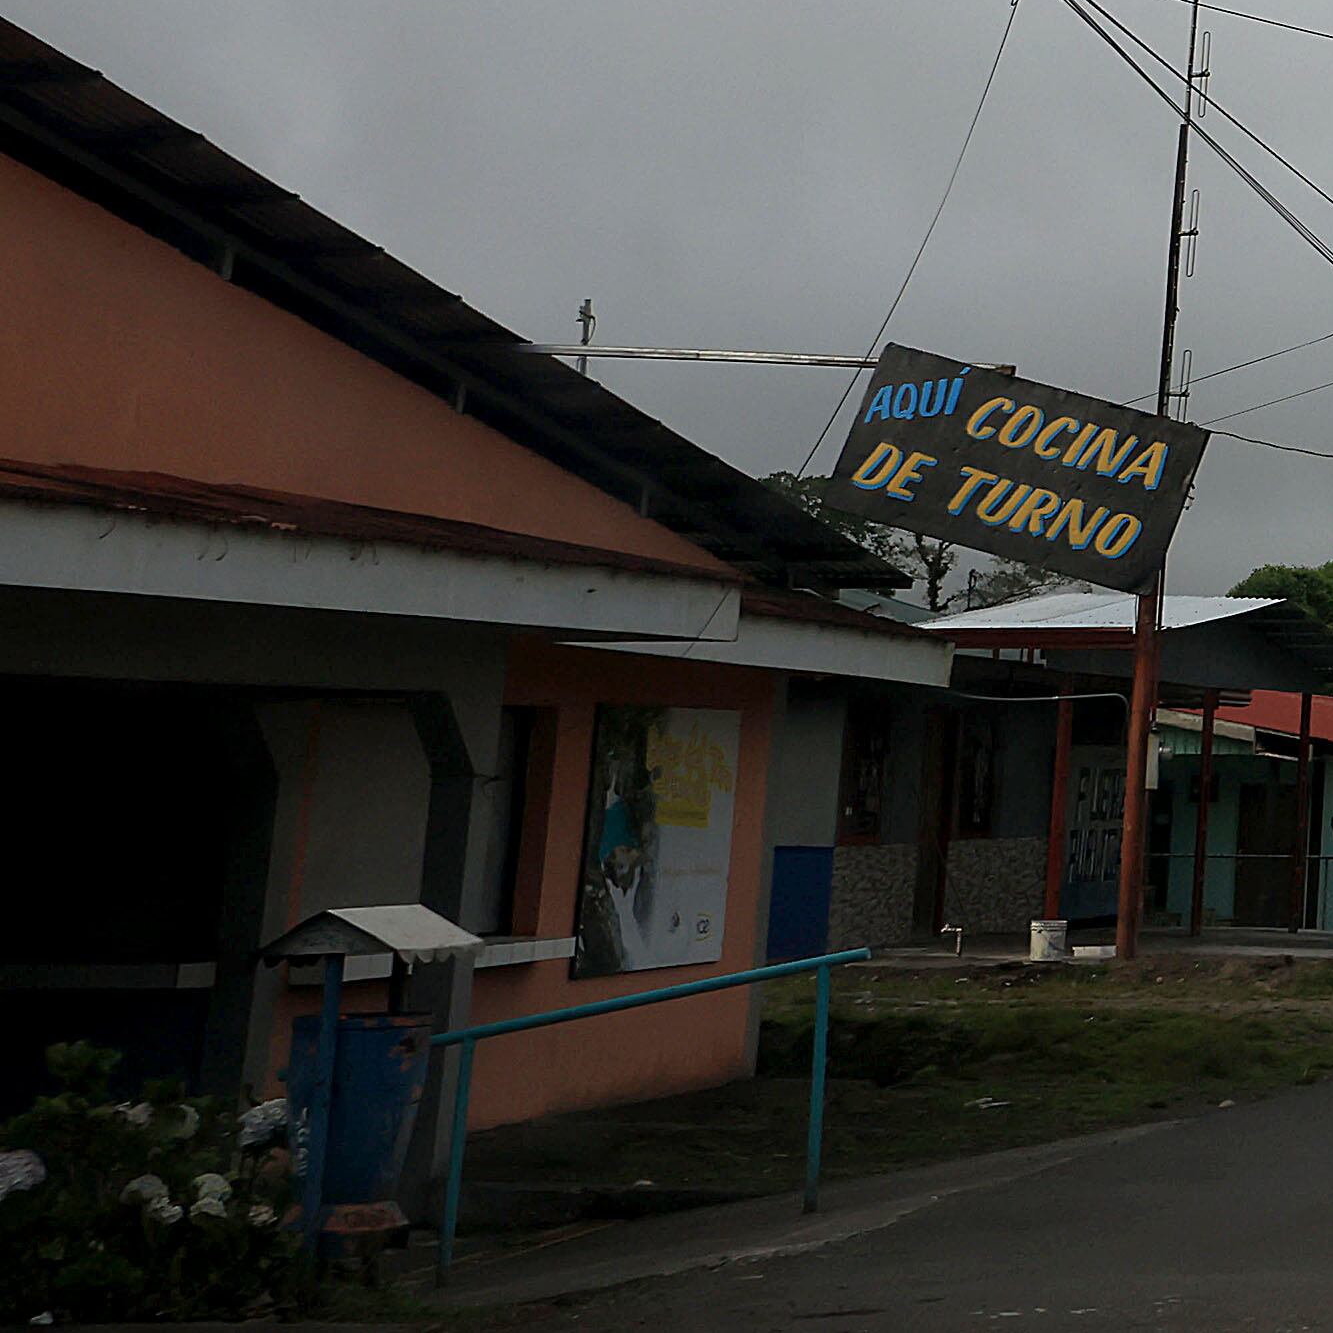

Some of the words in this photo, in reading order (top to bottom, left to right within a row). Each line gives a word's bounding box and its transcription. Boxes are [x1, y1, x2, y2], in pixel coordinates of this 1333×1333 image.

[966, 396, 1169, 491] COCINA
[852, 442, 939, 502] DE
[946, 466, 1143, 559] TURNO
